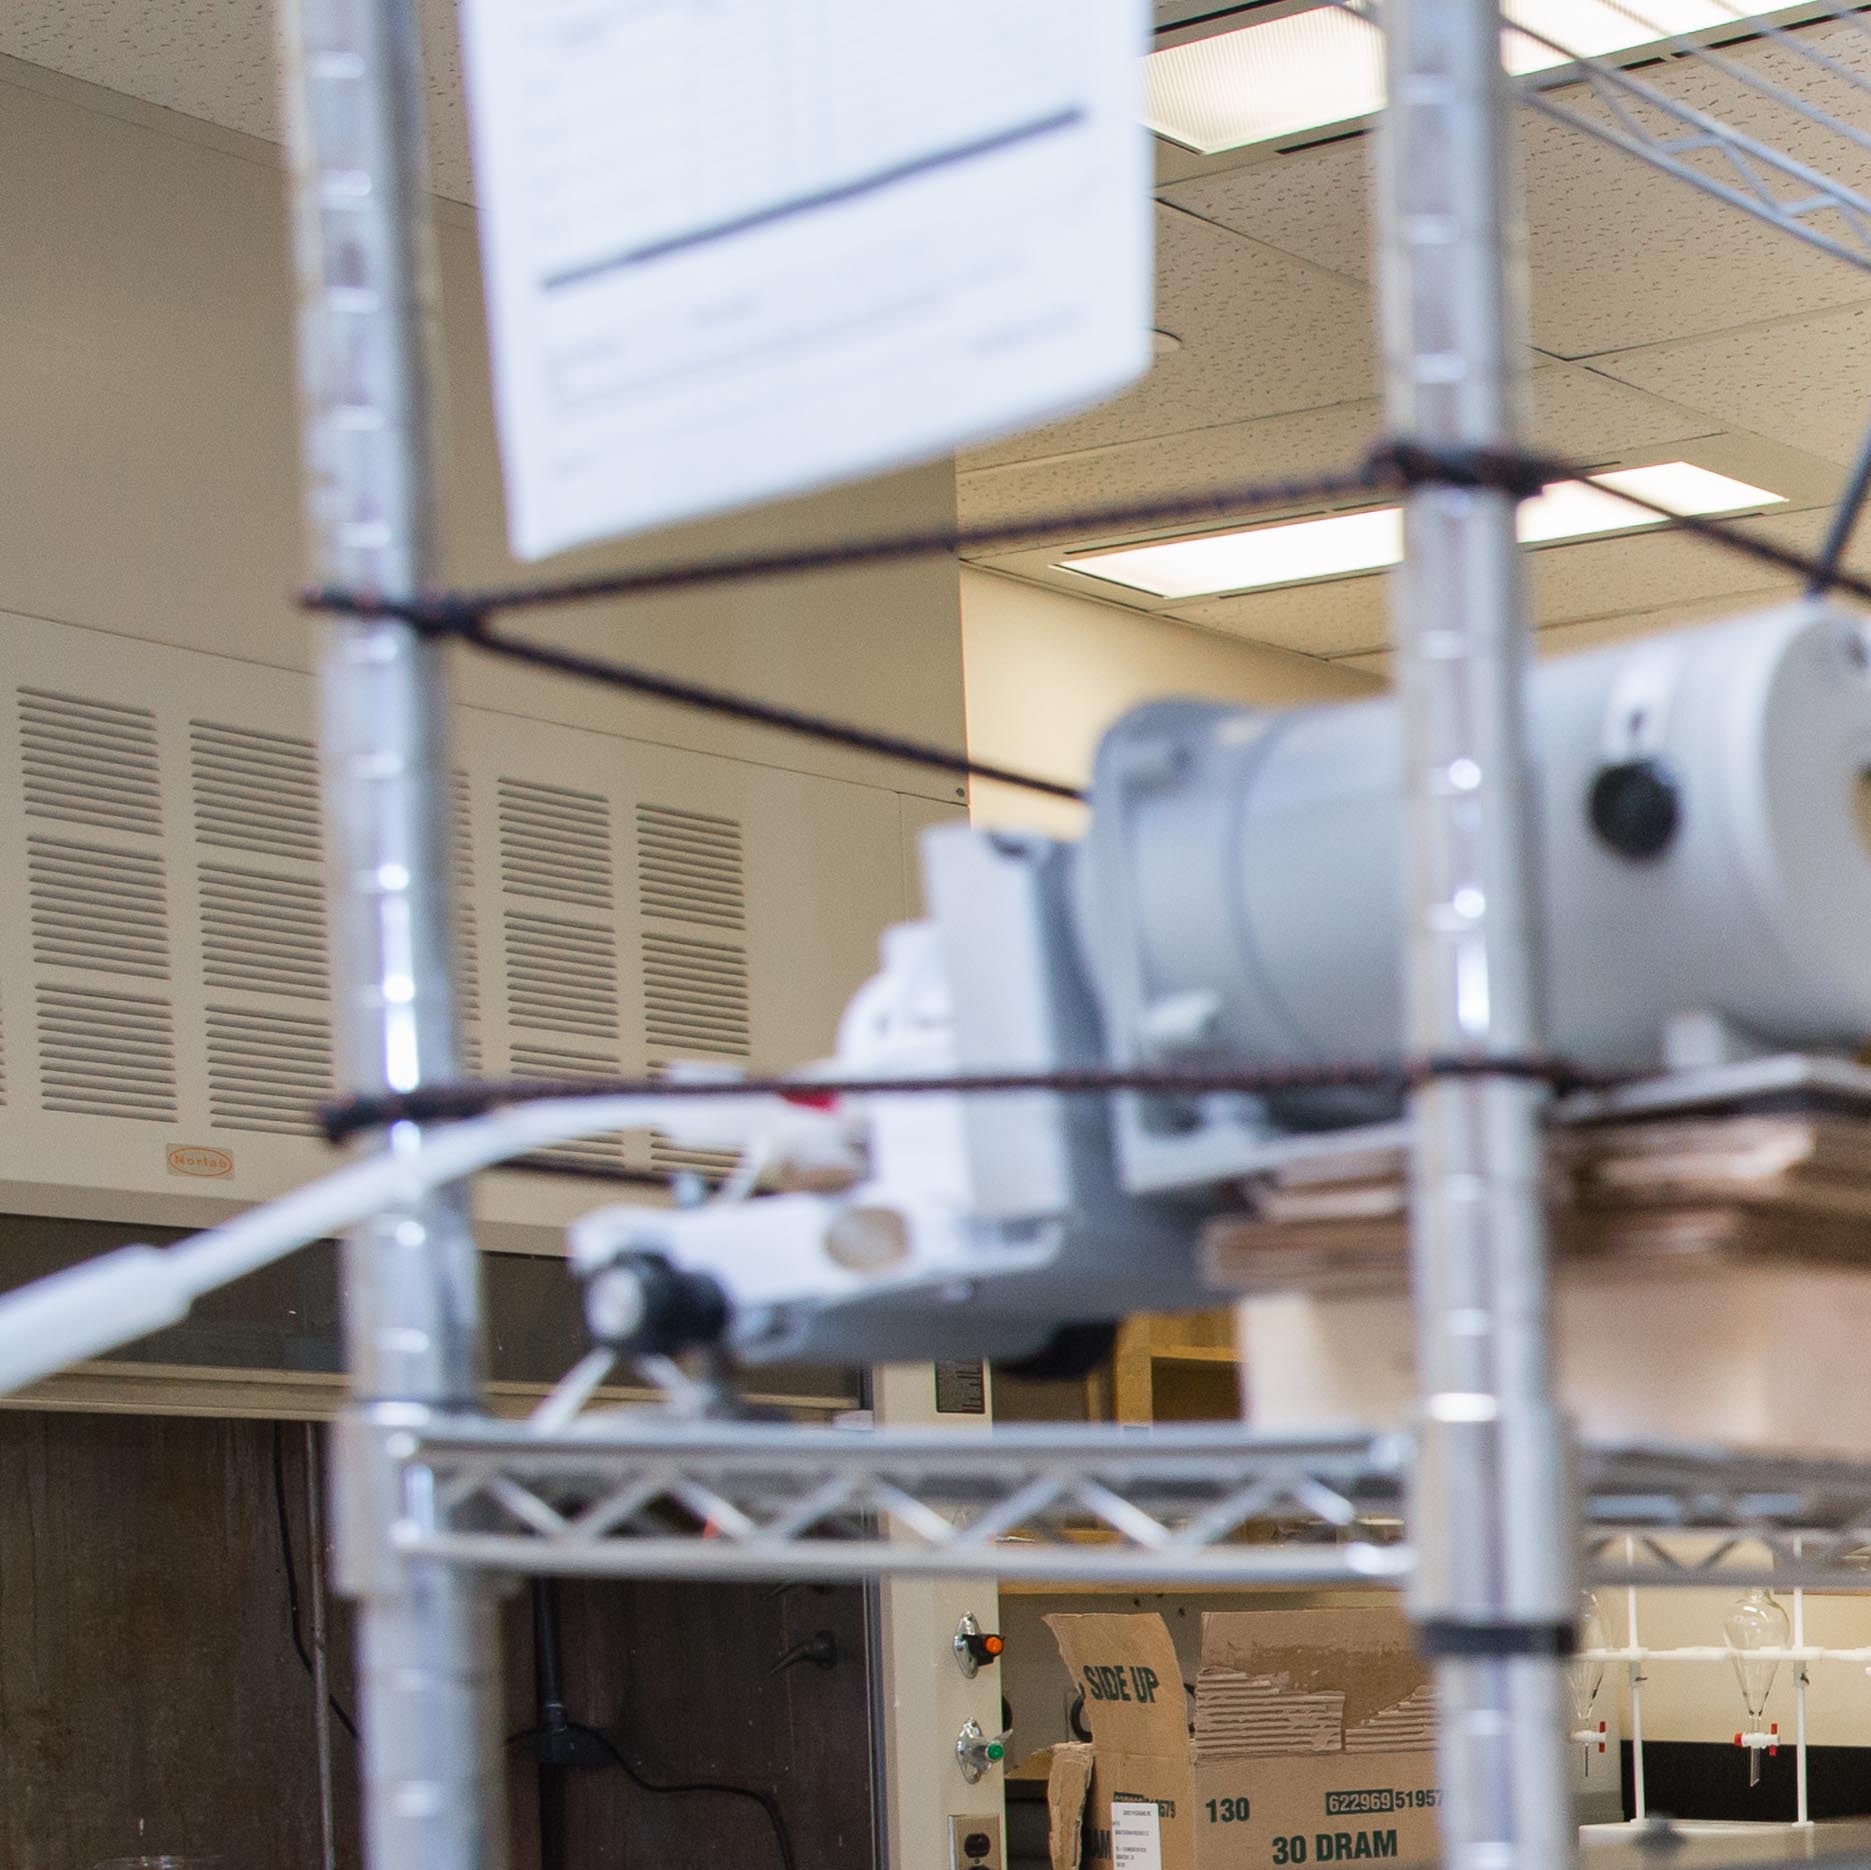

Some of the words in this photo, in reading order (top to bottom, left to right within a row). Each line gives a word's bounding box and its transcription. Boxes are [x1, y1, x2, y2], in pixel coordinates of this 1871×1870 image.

[1083, 1665, 1132, 1701] SIDE
[1130, 1666, 1160, 1704] UP
[1205, 1797, 1250, 1824] 130
[1328, 1792, 1393, 1813] 622969
[1272, 1835, 1307, 1865] 30
[1316, 1829, 1398, 1863] DRAM
